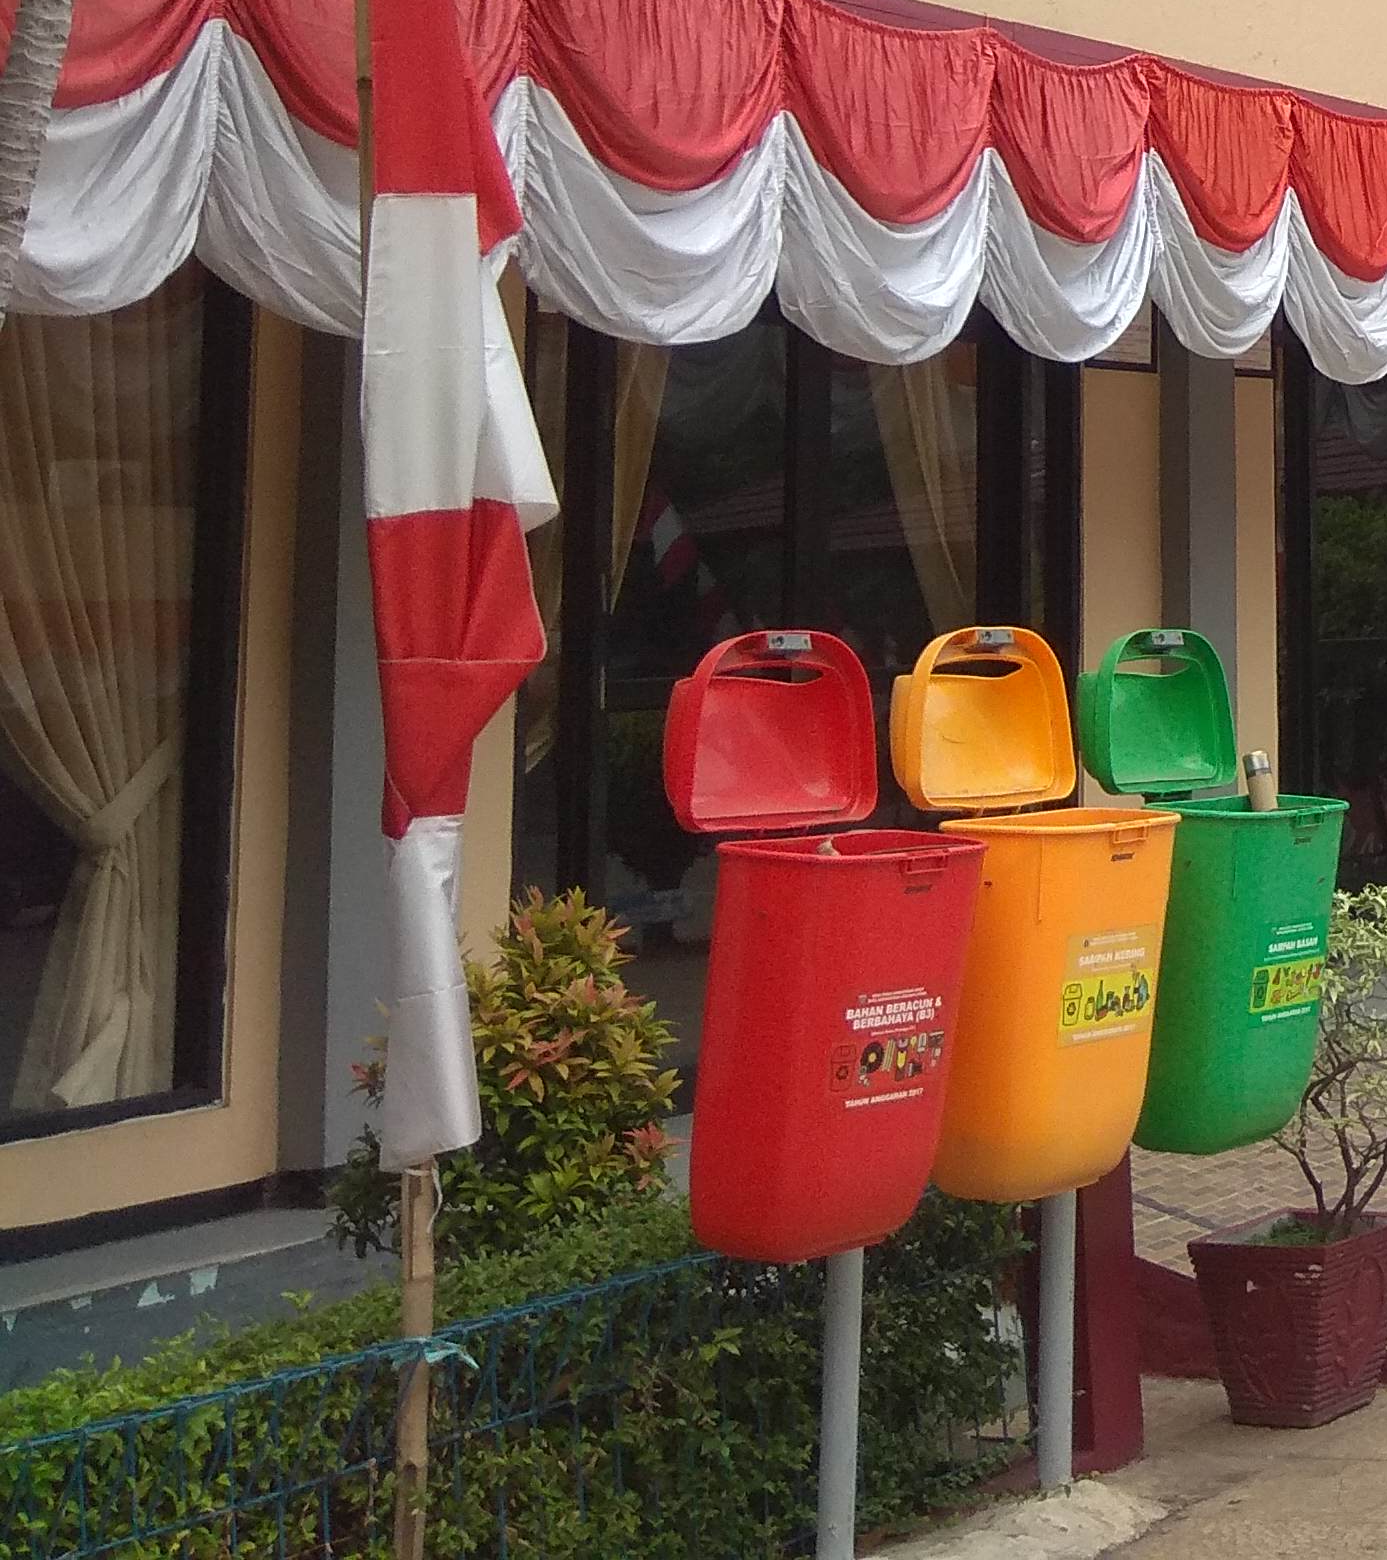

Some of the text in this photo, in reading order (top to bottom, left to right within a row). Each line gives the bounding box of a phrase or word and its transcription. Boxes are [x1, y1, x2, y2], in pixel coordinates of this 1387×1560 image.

[846, 1005, 884, 1020] BAHAN
[886, 997, 934, 1014] BERACUN
[852, 1011, 914, 1031] BERBAHAYA
